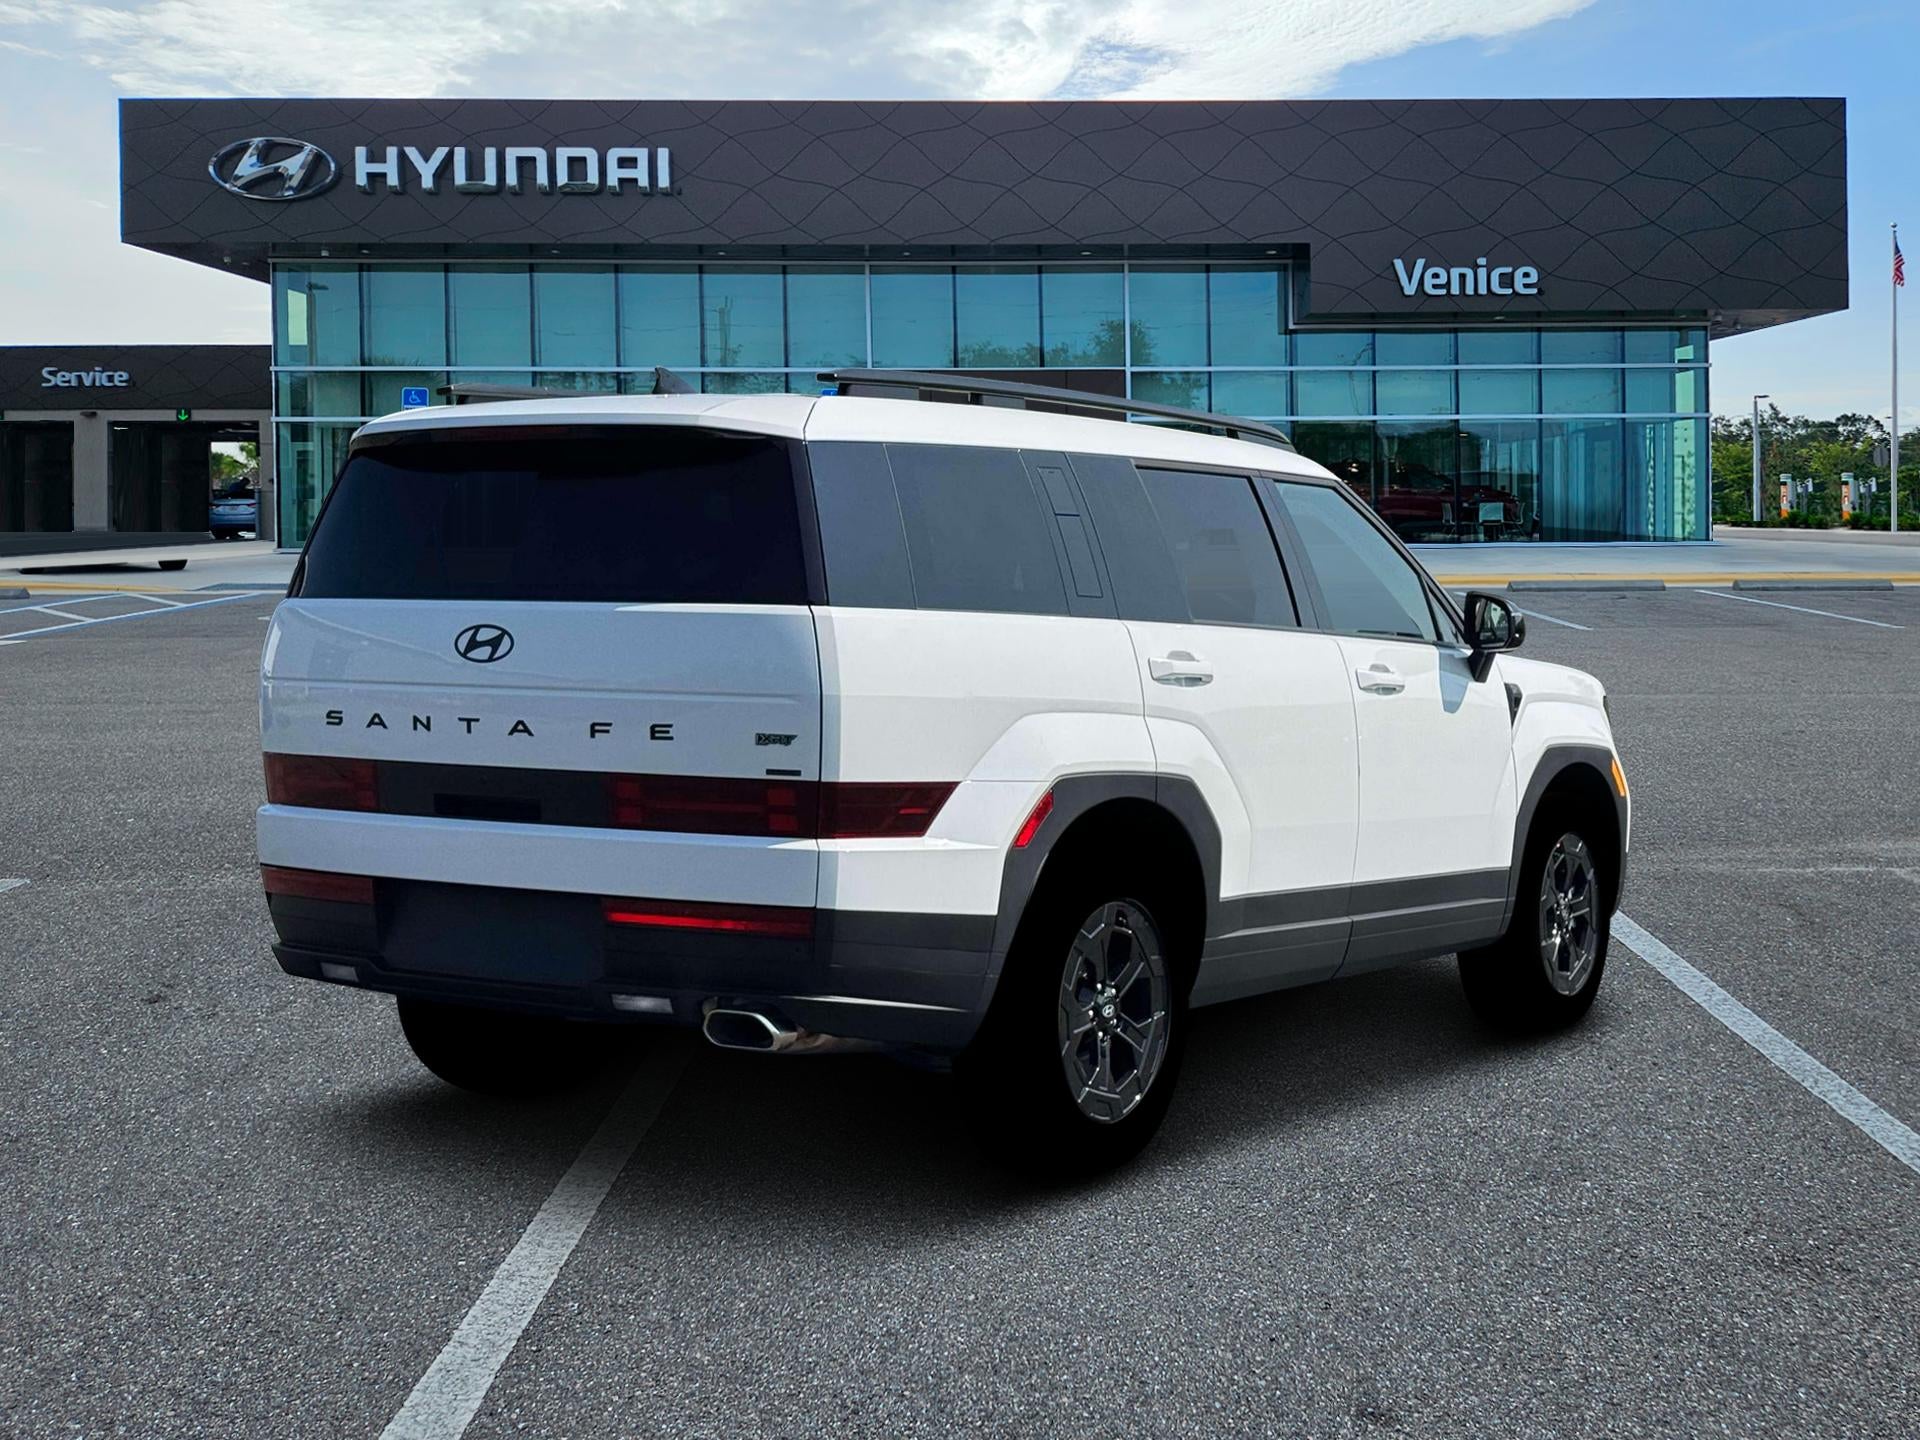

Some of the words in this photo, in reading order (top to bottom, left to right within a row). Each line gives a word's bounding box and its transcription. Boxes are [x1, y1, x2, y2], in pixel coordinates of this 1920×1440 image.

[354, 146, 673, 195] HYUNDAI
[1393, 257, 1539, 296] Venice
[41, 366, 130, 388] Service
[325, 710, 535, 738] SANTA
[589, 721, 674, 742] FE
